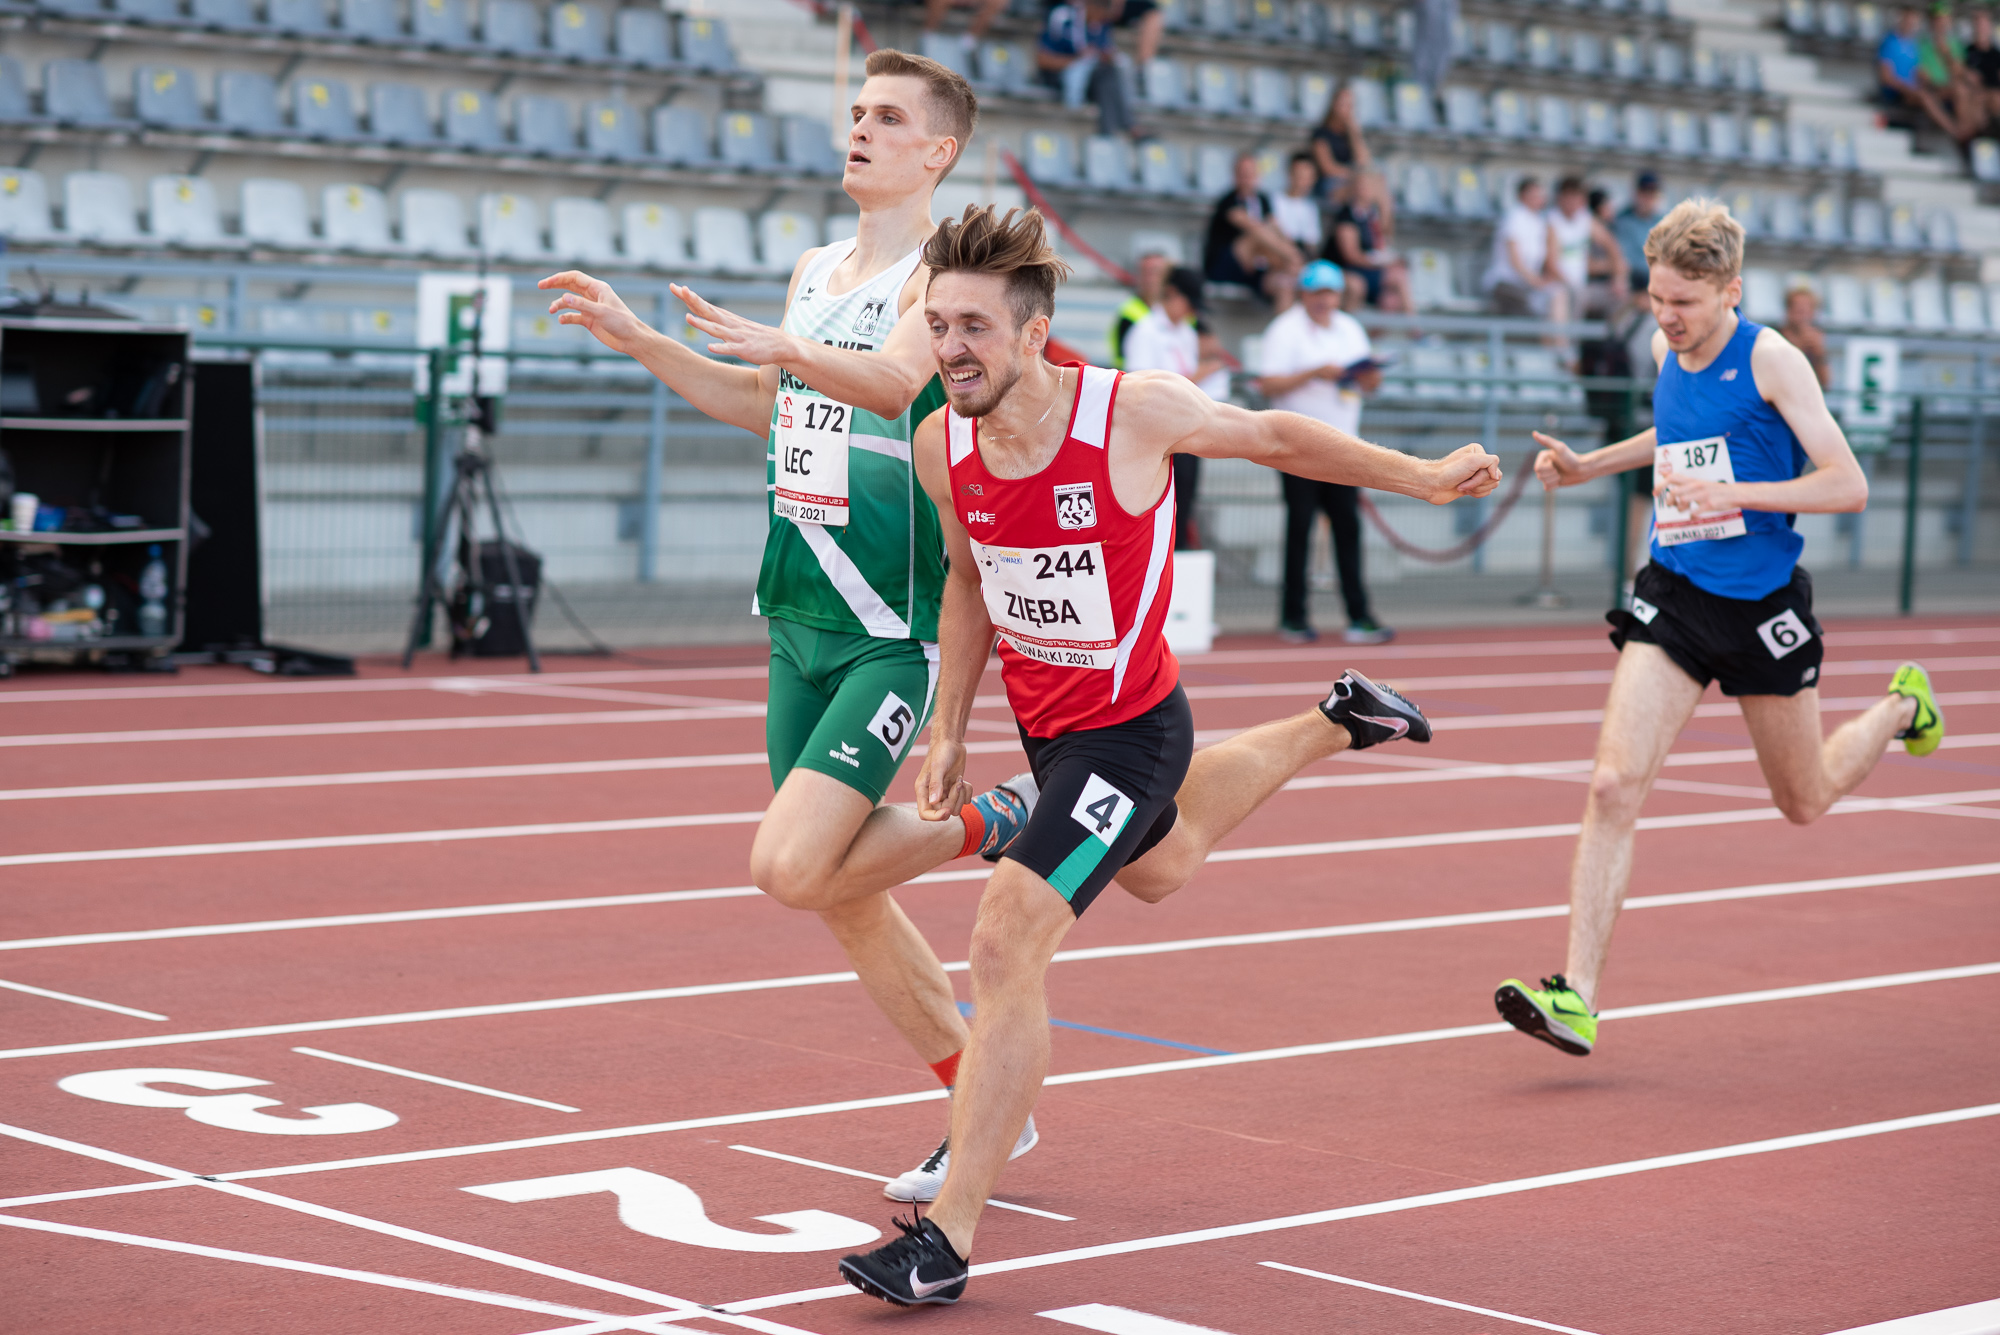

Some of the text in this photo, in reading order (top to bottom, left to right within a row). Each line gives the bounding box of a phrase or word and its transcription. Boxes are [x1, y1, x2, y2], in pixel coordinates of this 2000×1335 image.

[805, 402, 845, 433] 172
[785, 447, 813, 476] LEC
[1684, 443, 1718, 468] 187
[799, 506, 826, 521] 2021
[806, 495, 828, 504] POLSKI
[828, 498, 844, 506] U23
[1703, 525, 1726, 539] 2021
[1033, 549, 1096, 580] 244
[1004, 590, 1081, 628] ZIĘBA
[1021, 634, 1068, 647] MISTRZOSTWA
[1068, 641, 1093, 649] POLSKI
[1770, 620, 1799, 648] 6
[1014, 640, 1095, 666] SUWAŁKI 2021
[882, 704, 912, 746] 5
[829, 749, 860, 769] erima
[1085, 793, 1121, 834] 4
[57, 1068, 400, 1135] 3
[460, 1166, 882, 1253] 2
